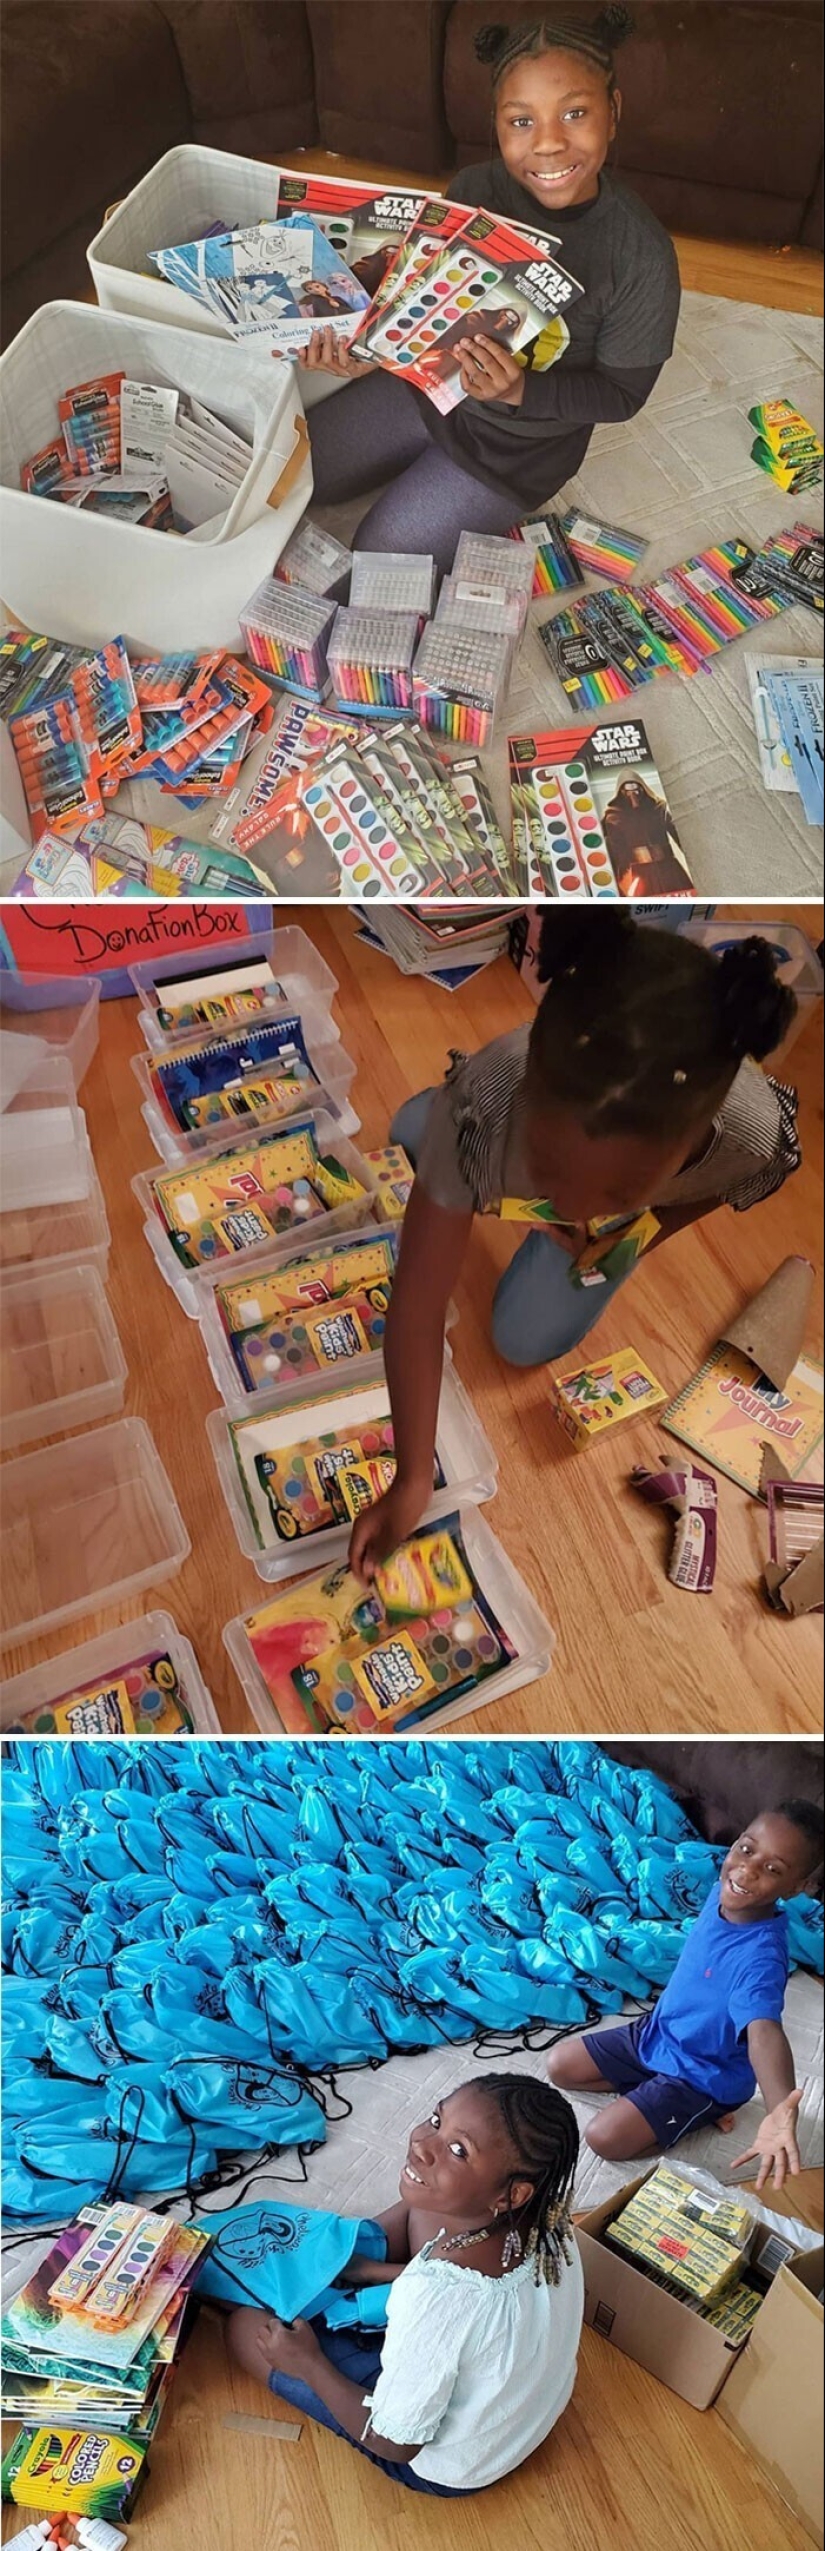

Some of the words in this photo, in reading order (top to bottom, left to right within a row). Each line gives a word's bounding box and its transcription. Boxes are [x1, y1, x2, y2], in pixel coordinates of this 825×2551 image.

[375, 204, 418, 219] WAR
[524, 265, 567, 304] WARS
[531, 262, 573, 298] STAR
[272, 327, 309, 340] Coloring
[802, 693, 823, 733] FROZEN
[591, 736, 641, 753] WARS
[595, 725, 640, 741] STAR
[246, 701, 312, 810] PAWSOME
[192, 904, 242, 937] Box
[313, 1323, 338, 1362] Paint
[717, 1375, 806, 1439] Journal
[345, 1474, 362, 1516] Crayola
[680, 1540, 693, 1567] GLITTER
[685, 1554, 700, 1585] MYSTICAL
[676, 1566, 688, 1583] GLUE
[390, 1642, 425, 1691] Paint
[7, 2465, 21, 2477] 12
[28, 2437, 50, 2473] Crayola
[68, 2434, 98, 2485] COLORED
[79, 2437, 110, 2482] PENCILS
[120, 2457, 133, 2471] 12
